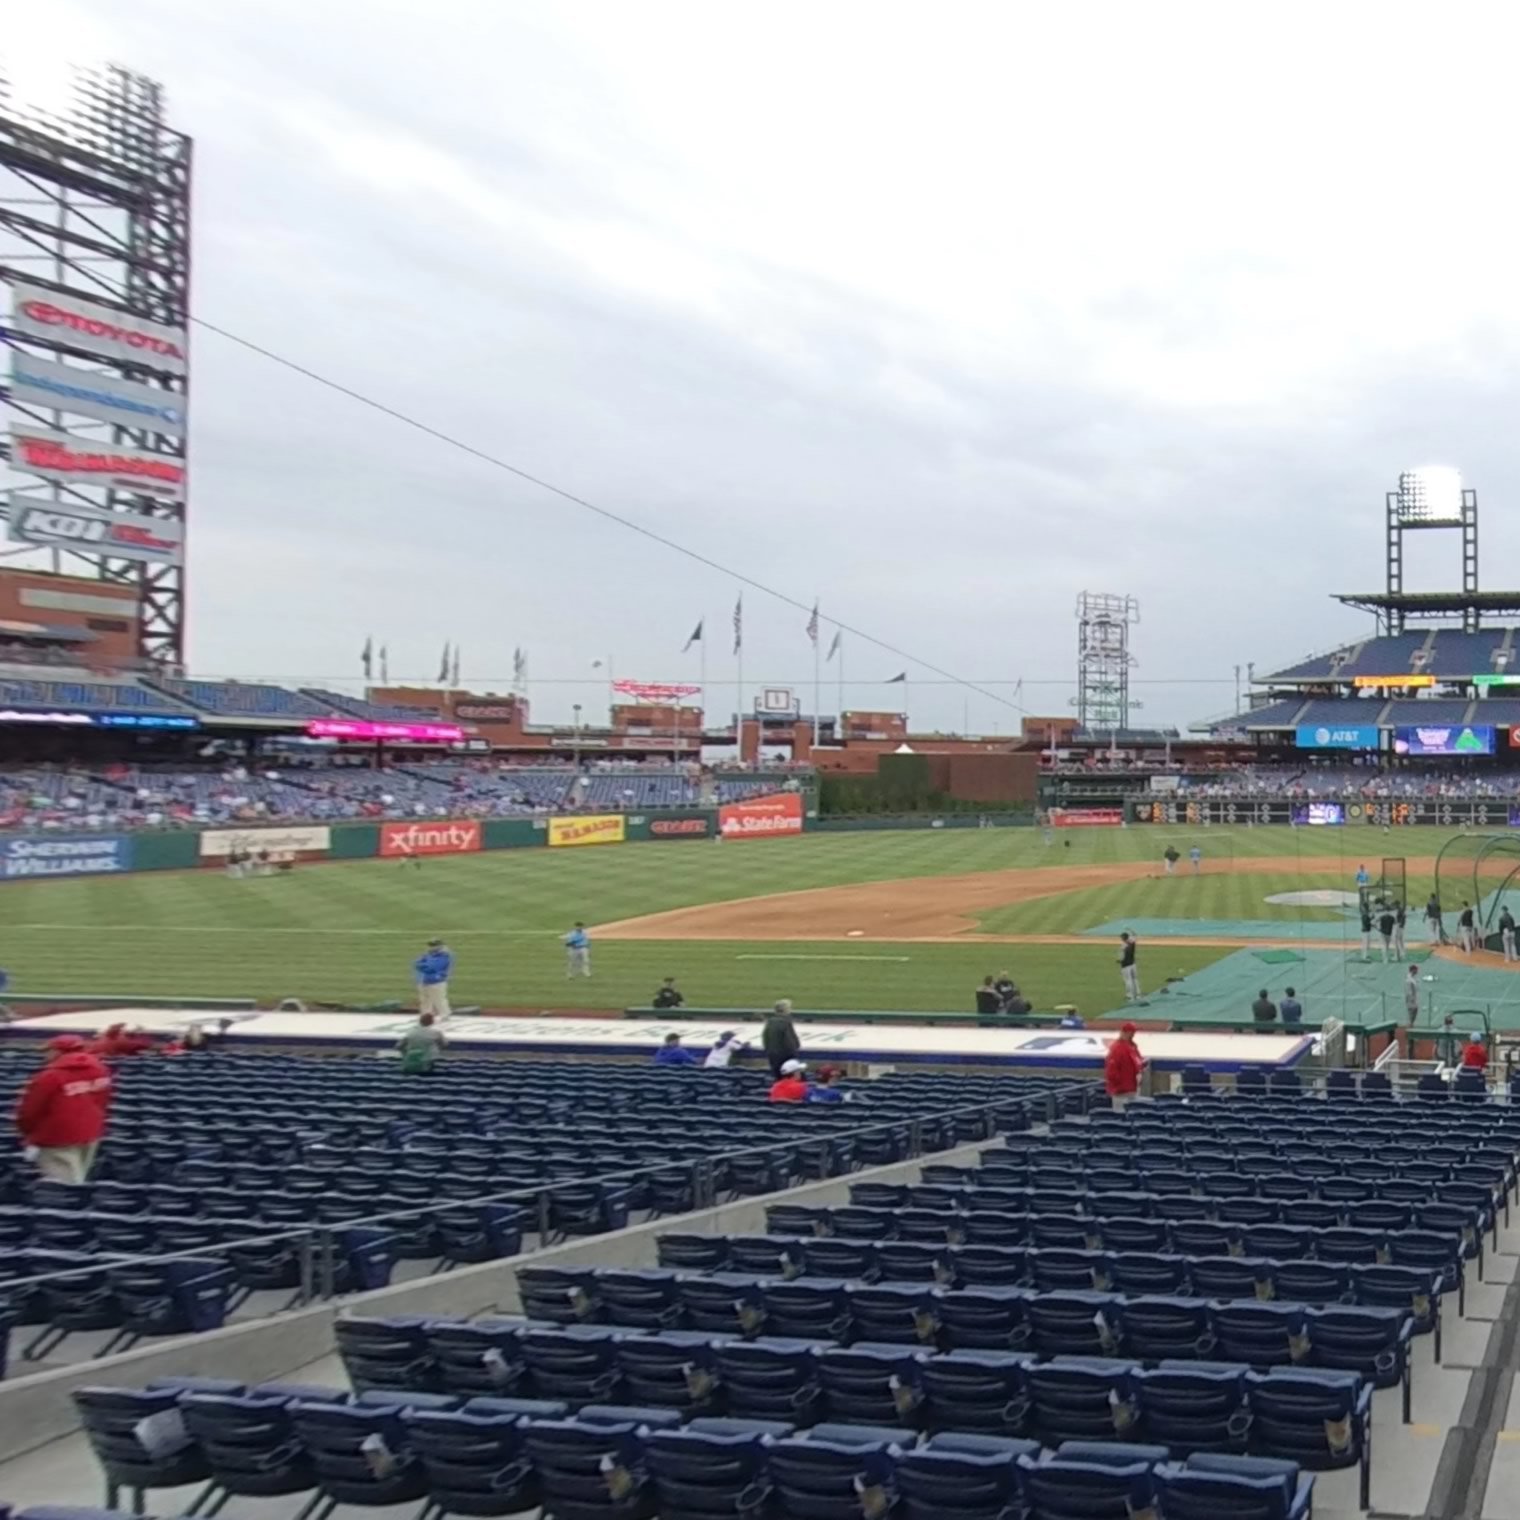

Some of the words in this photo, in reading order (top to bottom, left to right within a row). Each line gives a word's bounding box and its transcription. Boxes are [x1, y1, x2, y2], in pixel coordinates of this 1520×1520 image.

[61, 312, 183, 360] TOYOTA
[1332, 730, 1360, 743] AT&T
[743, 816, 774, 832] State
[774, 814, 803, 830] Farm
[389, 825, 475, 853] xfinity
[6, 841, 118, 858] SHERWIN
